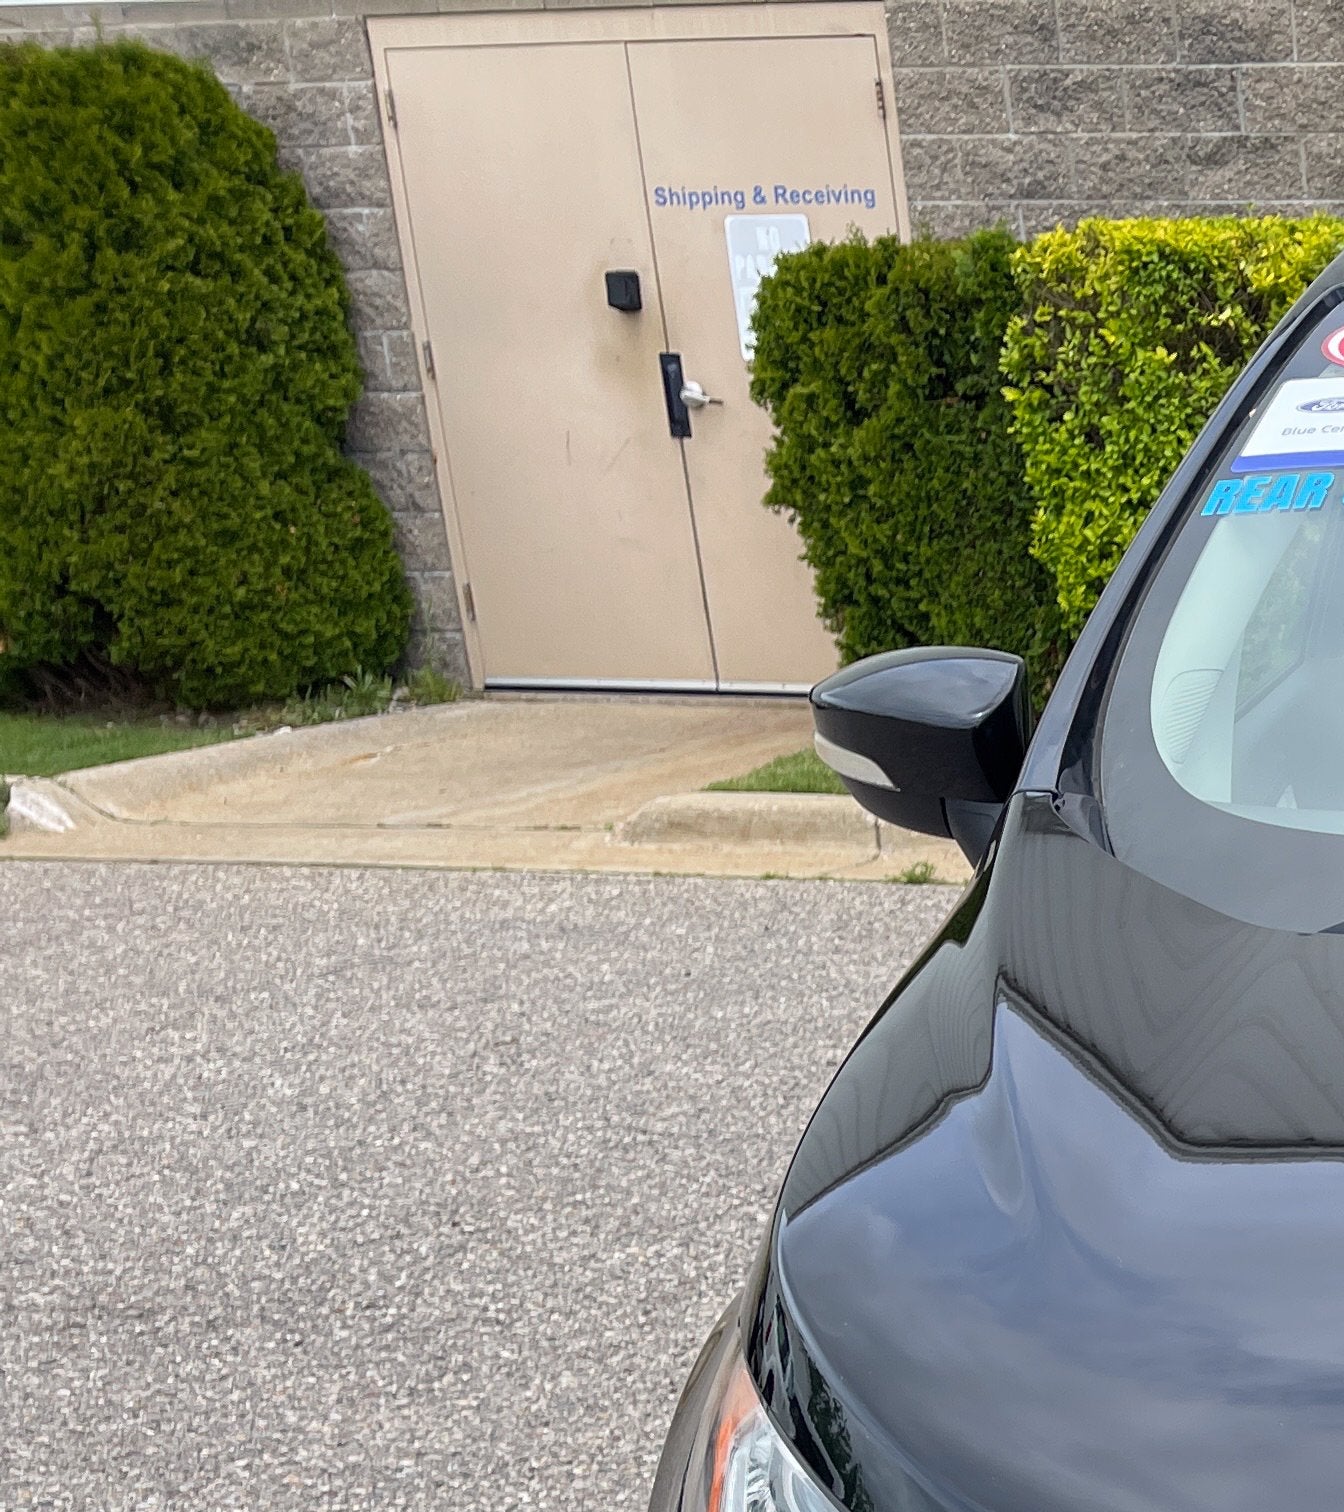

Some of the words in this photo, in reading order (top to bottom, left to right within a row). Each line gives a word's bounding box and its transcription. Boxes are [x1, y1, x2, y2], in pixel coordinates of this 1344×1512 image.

[654, 186, 745, 210] Shipping
[753, 185, 767, 205] &
[774, 184, 876, 208] Receiving
[1280, 426, 1316, 436] Blue
[1201, 472, 1335, 517] REAR
